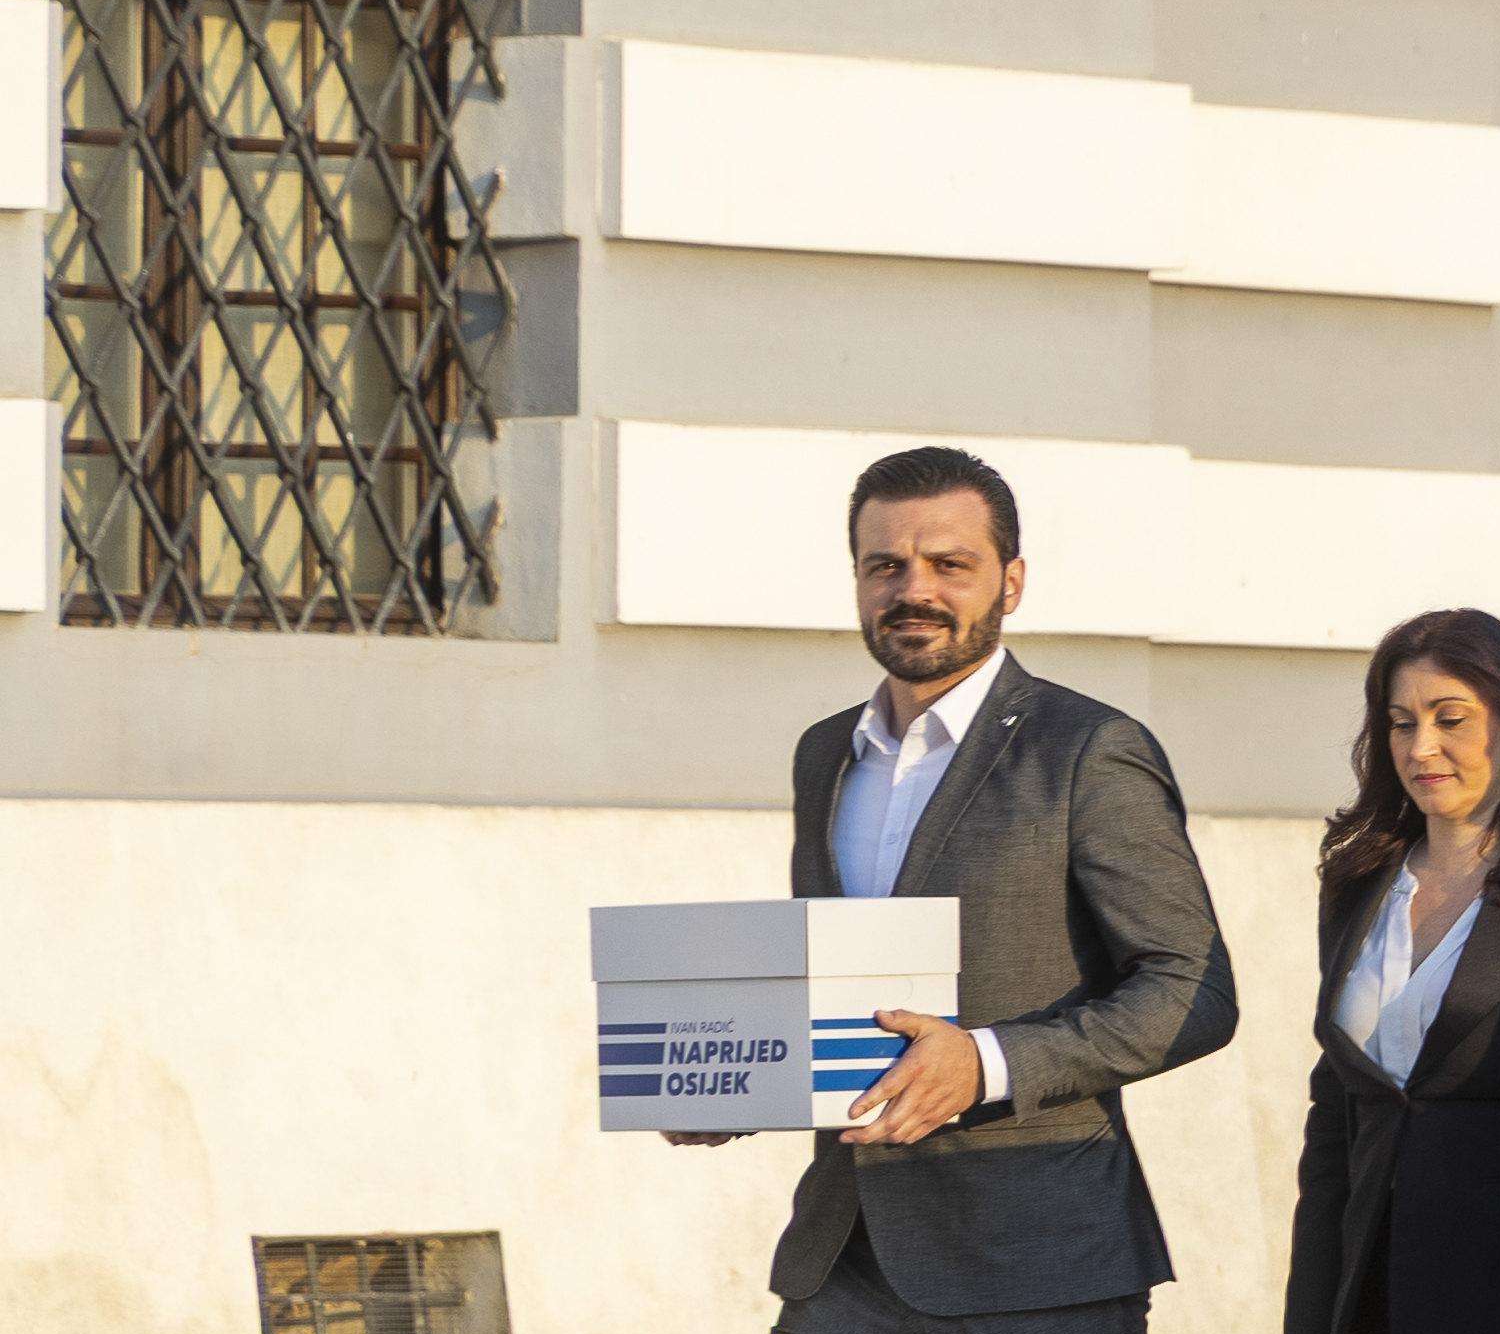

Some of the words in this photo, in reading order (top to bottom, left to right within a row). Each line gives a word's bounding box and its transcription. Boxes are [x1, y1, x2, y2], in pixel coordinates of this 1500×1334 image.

[670, 1021, 697, 1034] IVAN
[700, 1018, 735, 1034] RADIĆ
[668, 1039, 788, 1065] NAPRIJED
[666, 1071, 752, 1096] OSIJEK
